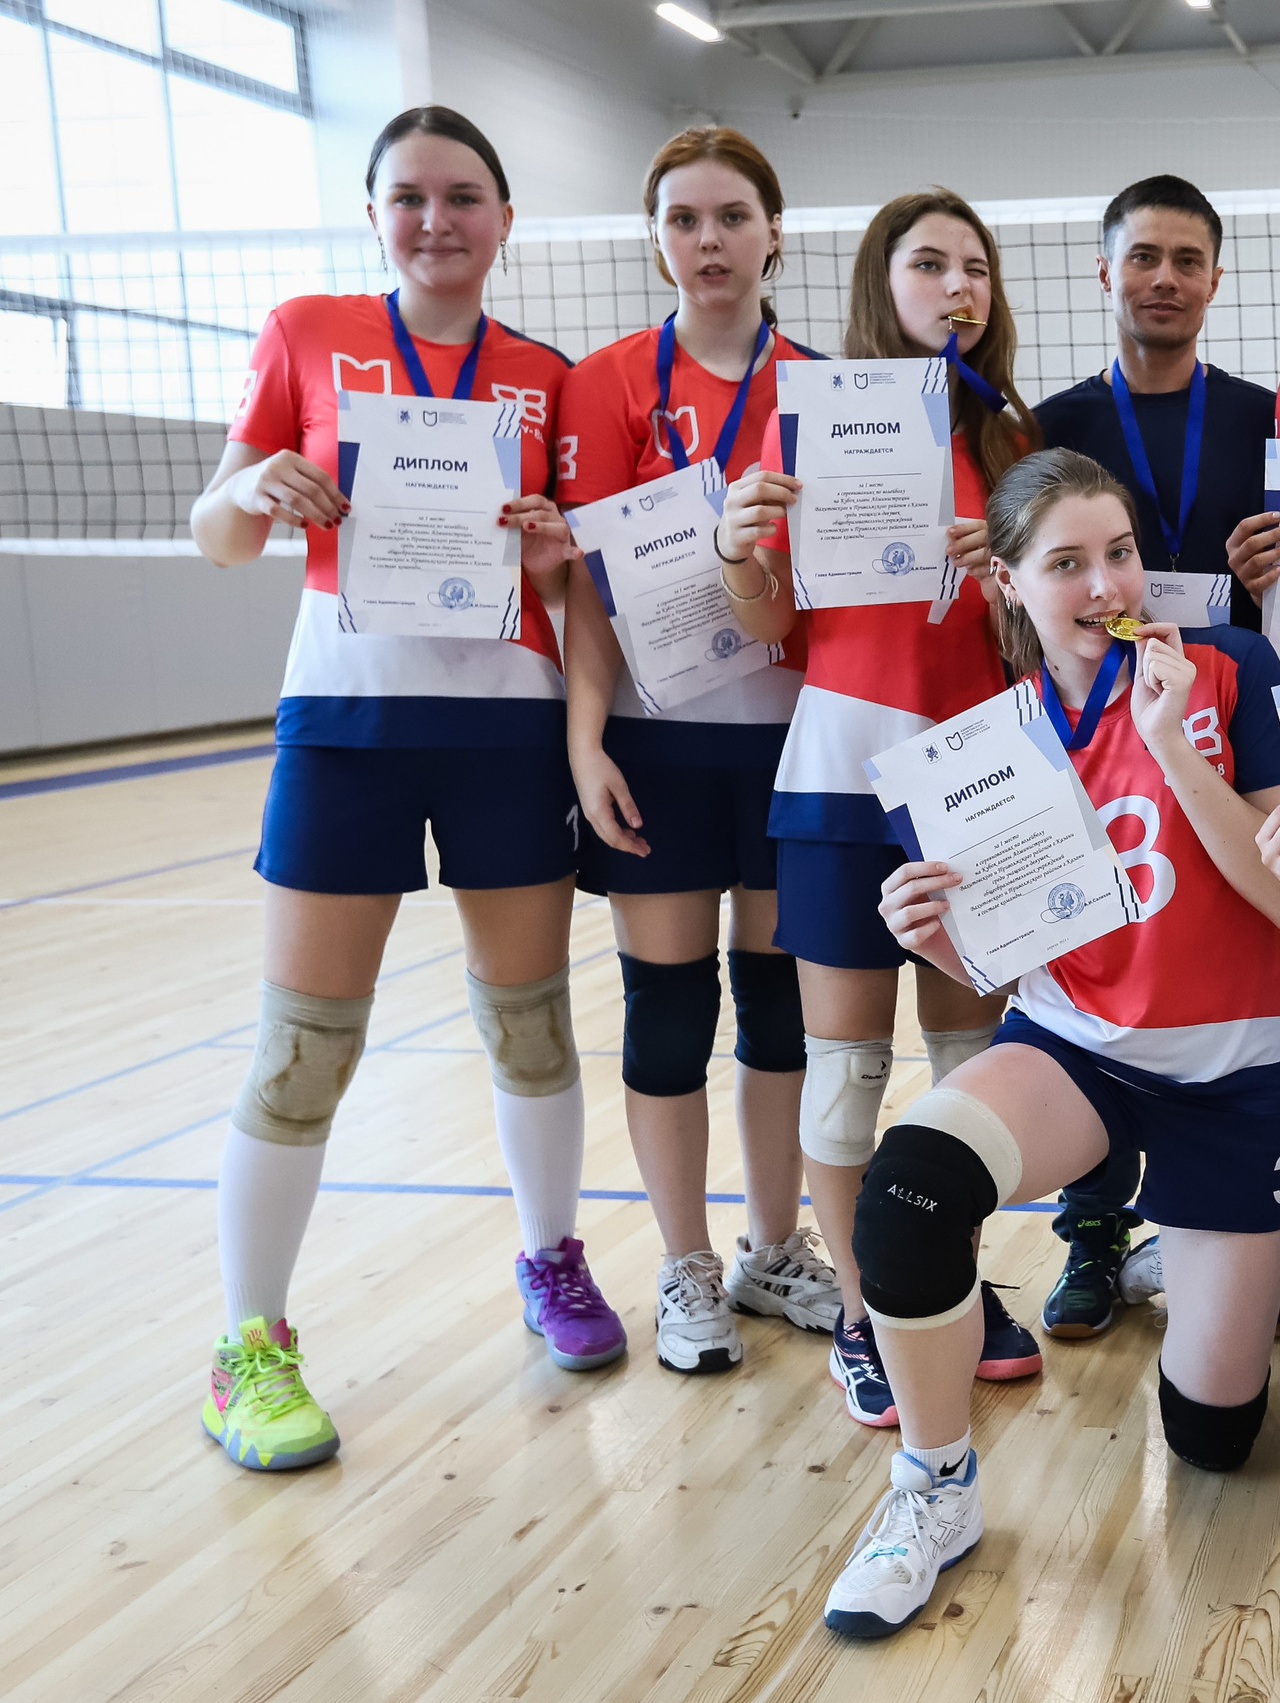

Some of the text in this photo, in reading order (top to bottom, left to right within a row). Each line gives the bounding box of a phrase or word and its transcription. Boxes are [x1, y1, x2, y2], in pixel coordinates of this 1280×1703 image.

[832, 422, 900, 438] ДИПЛОМ
[394, 457, 468, 472] ДИПЛОМ
[634, 527, 697, 559] ДИПЛОМ
[945, 766, 1014, 812] ДИПЛОМ
[965, 795, 1015, 822] НАГРАЖДАЕТСЯ
[886, 1182, 938, 1213] ALLSIX
